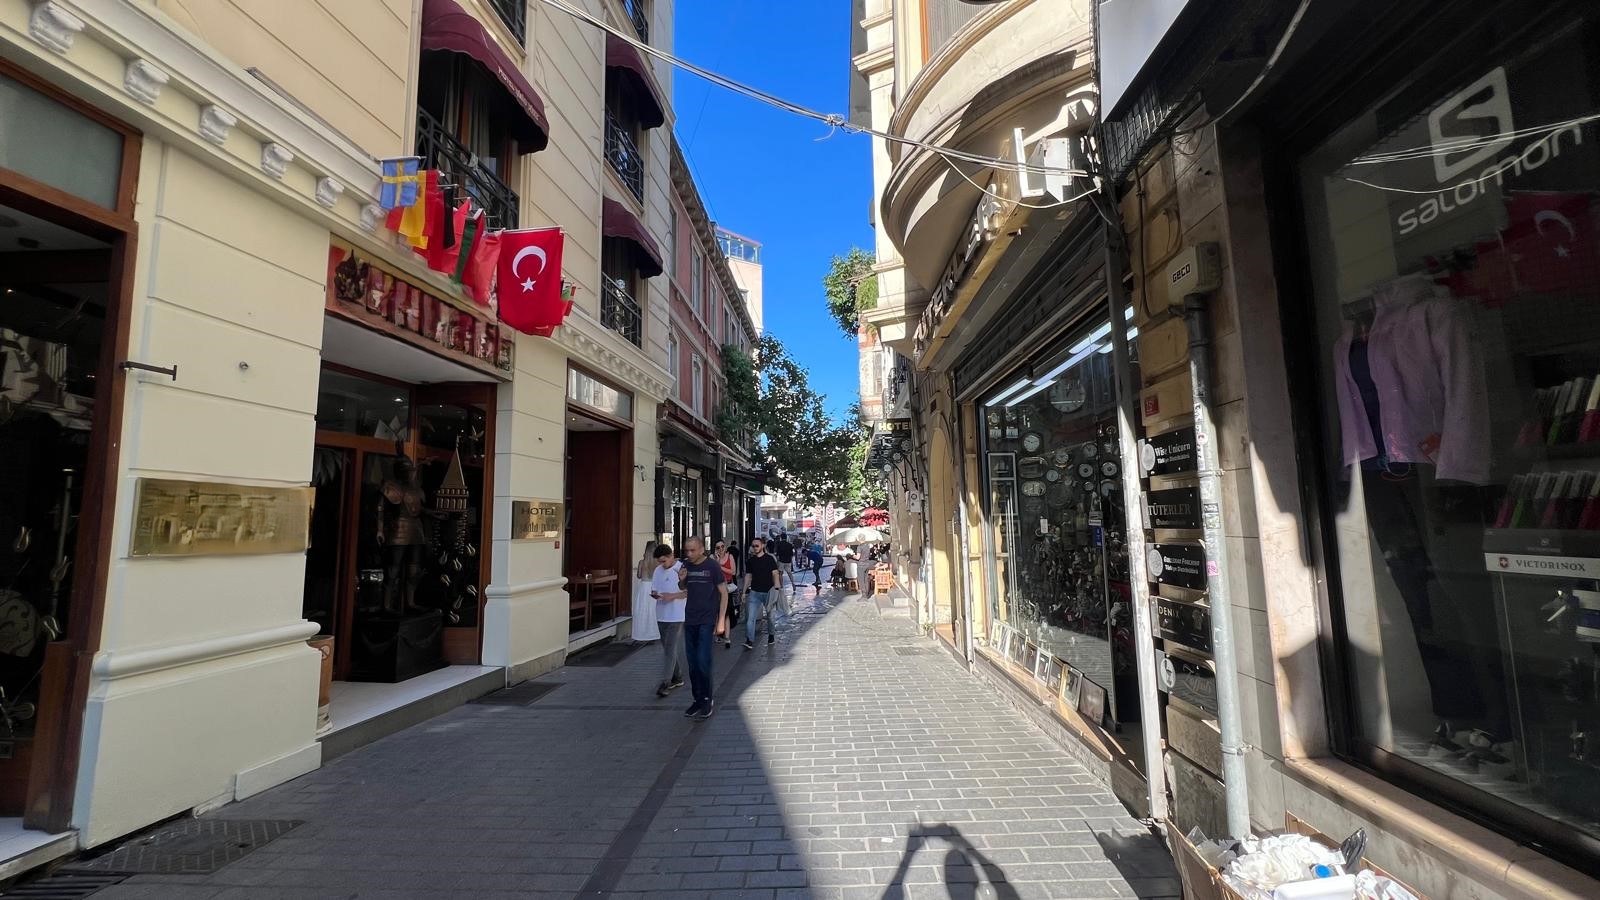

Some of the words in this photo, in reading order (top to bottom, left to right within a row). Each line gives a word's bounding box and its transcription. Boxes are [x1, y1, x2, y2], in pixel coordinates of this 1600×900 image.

[1168, 443, 1191, 454] Unicorn
[521, 507, 556, 516] HOTEL
[1515, 558, 1587, 572] VICTORINOX
